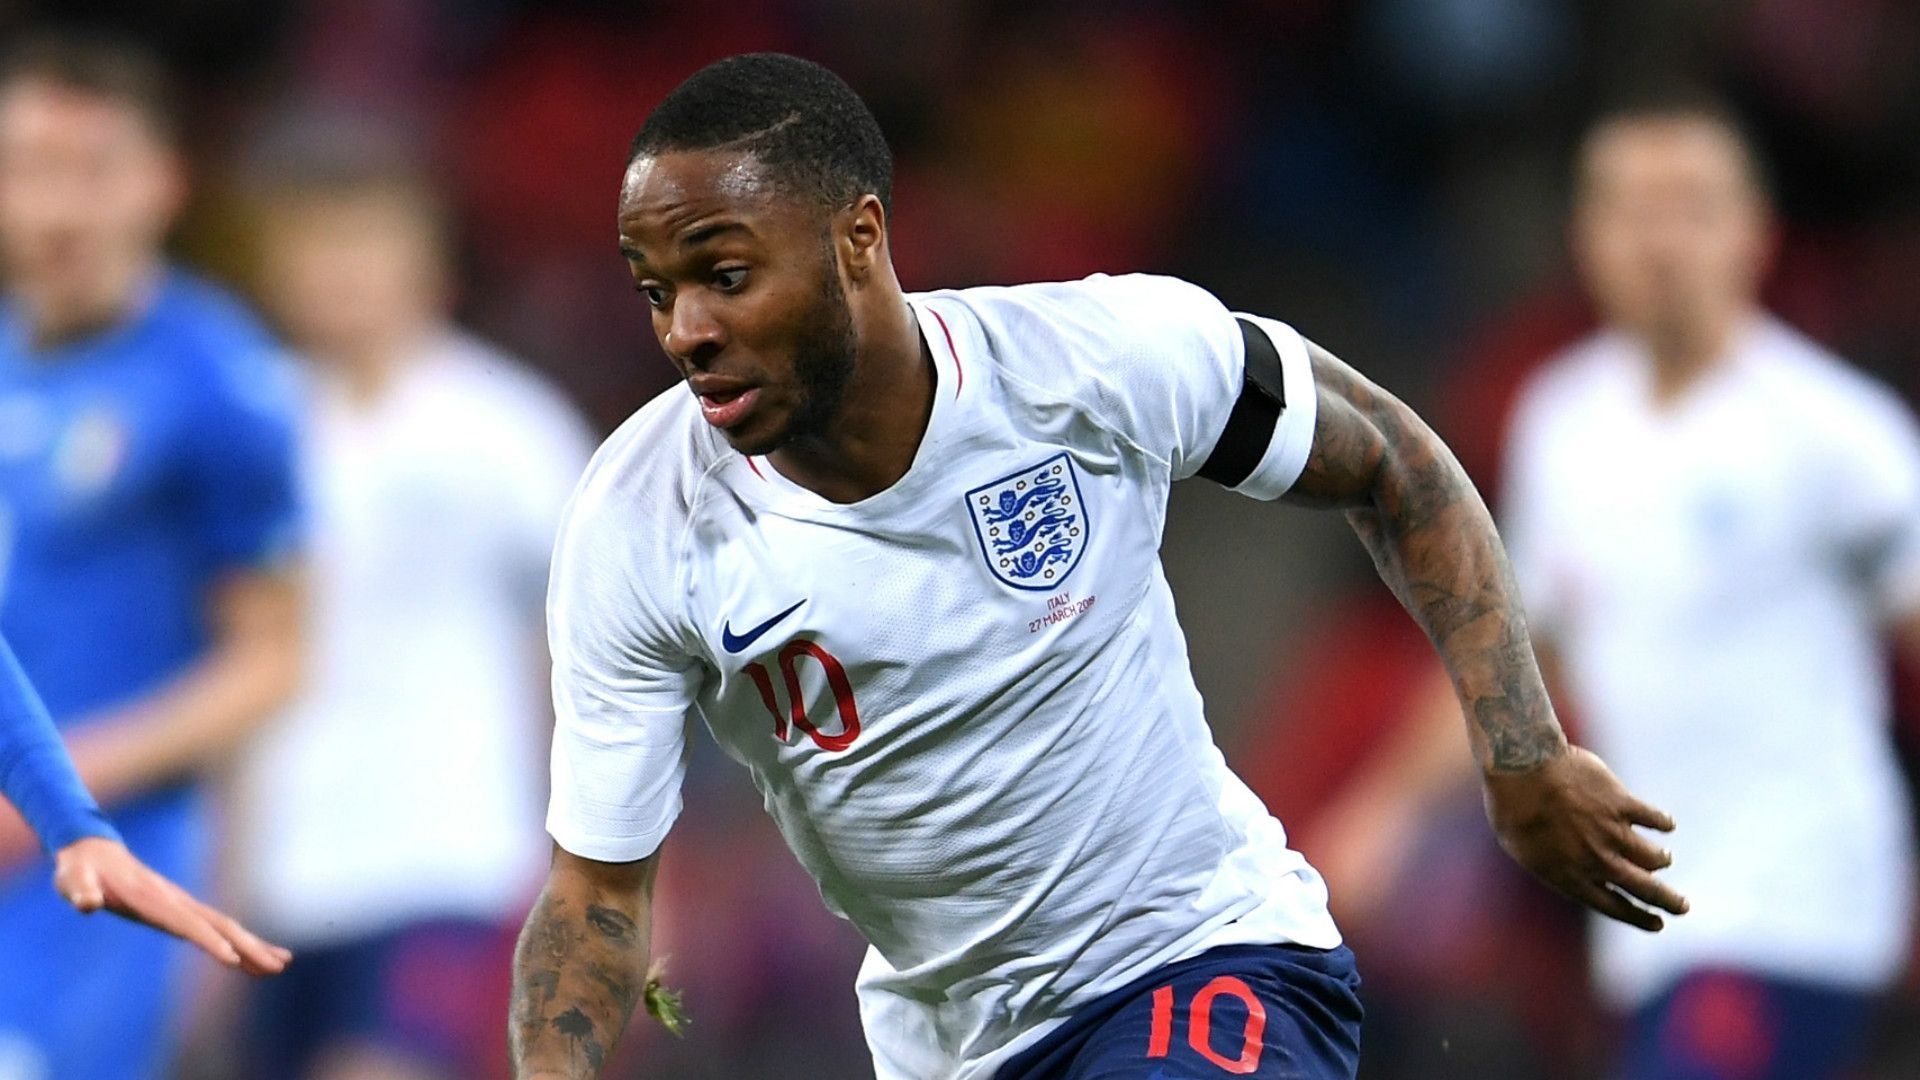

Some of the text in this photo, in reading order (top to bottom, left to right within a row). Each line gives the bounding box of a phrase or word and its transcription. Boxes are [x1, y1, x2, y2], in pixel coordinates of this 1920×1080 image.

[1029, 619, 1041, 633] 27
[1043, 605, 1076, 627] MARCH
[1047, 592, 1070, 610] ITALY
[741, 639, 861, 752] 10
[1147, 975, 1266, 1074] 10
